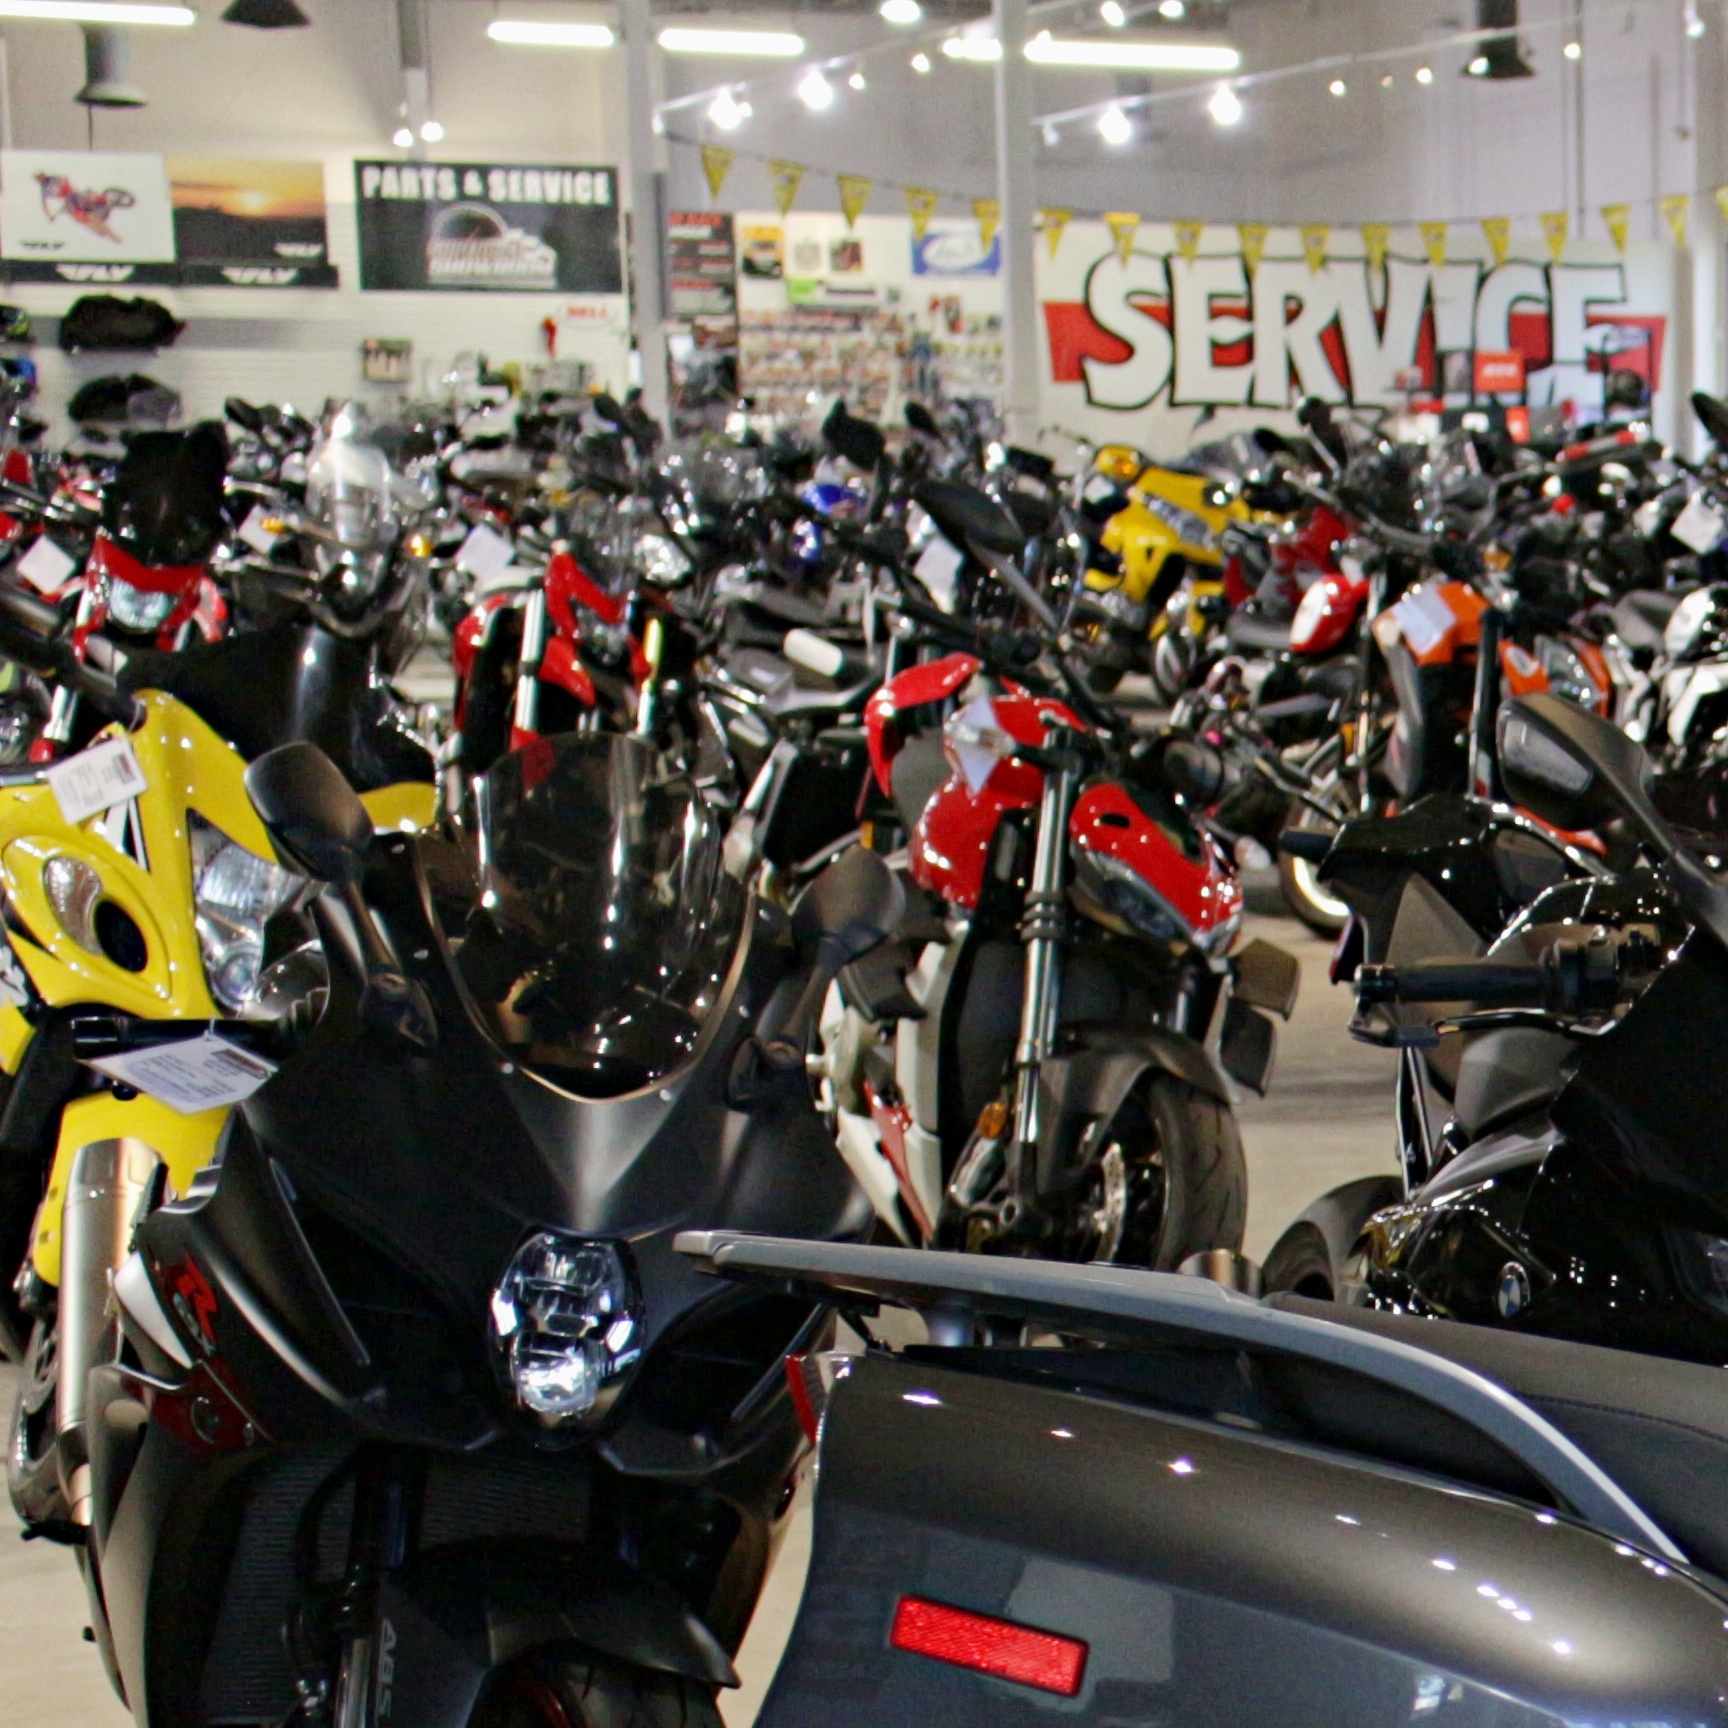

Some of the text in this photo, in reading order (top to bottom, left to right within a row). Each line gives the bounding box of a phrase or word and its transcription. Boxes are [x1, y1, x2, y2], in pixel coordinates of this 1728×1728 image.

[361, 164, 610, 205] PARTS & SERVICE
[1084, 251, 1628, 408] SERVICE
